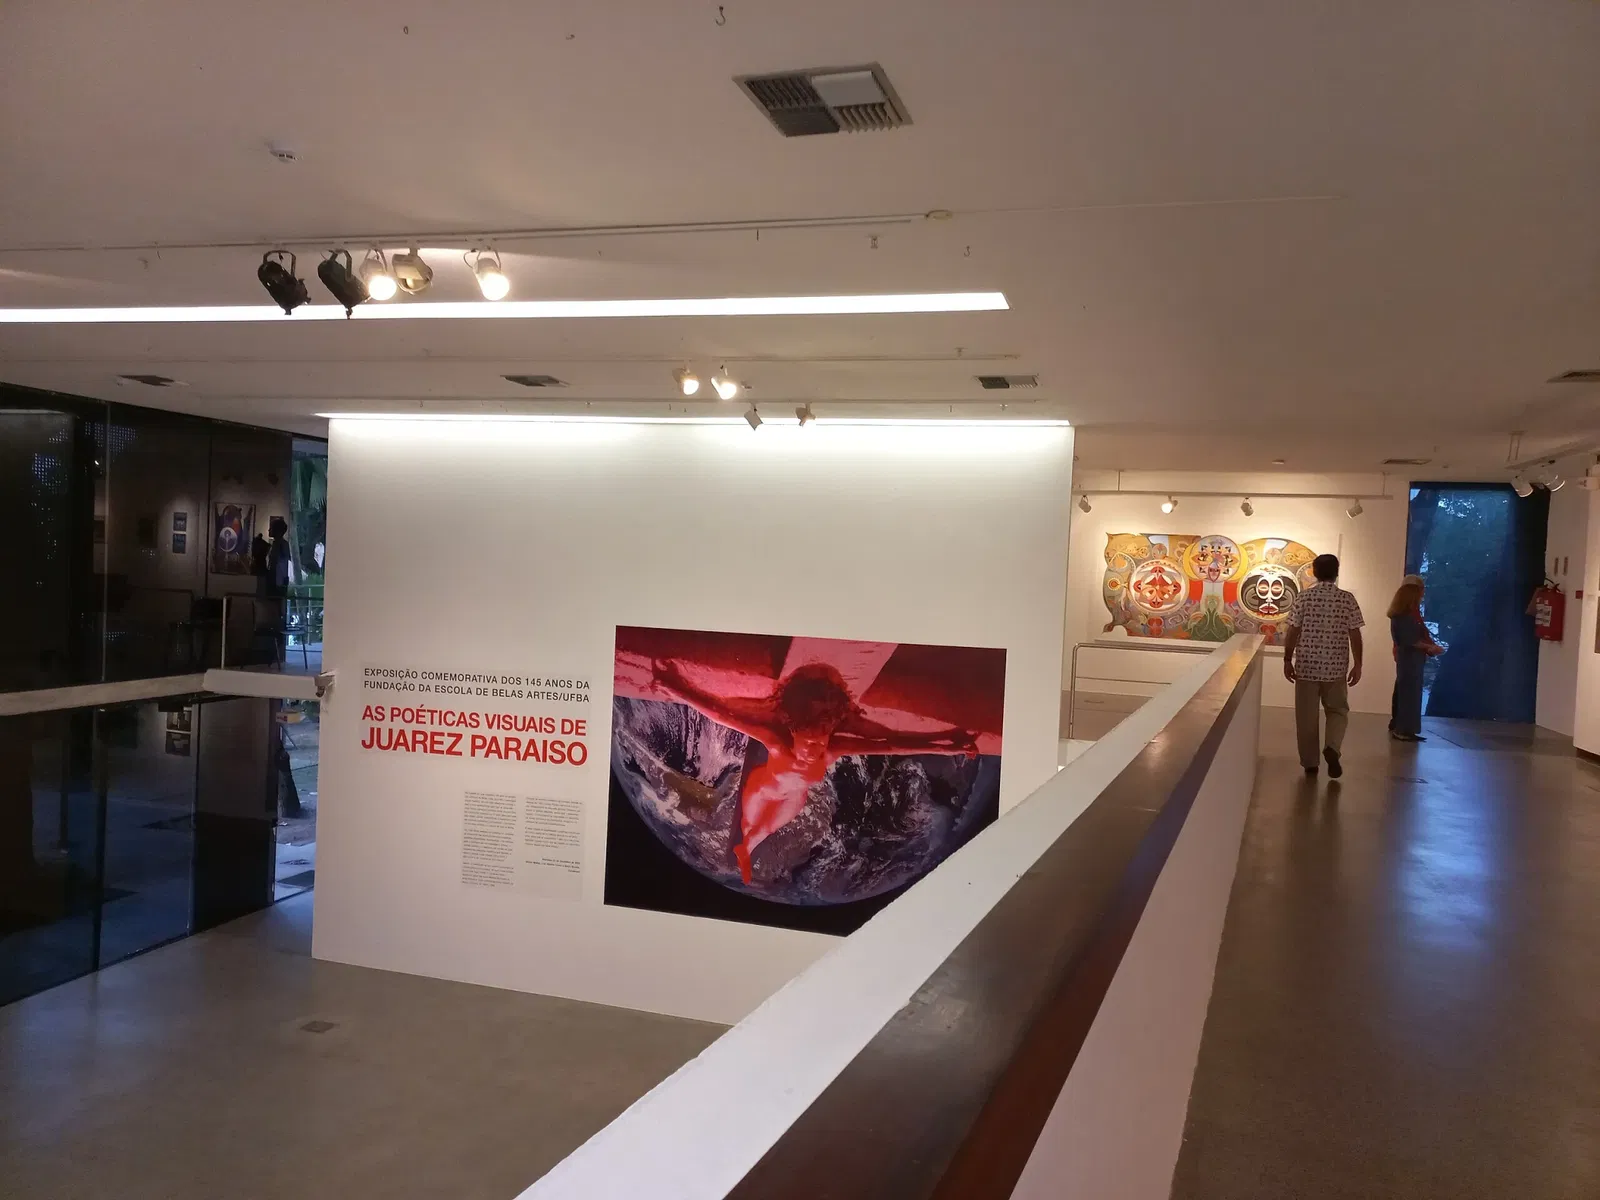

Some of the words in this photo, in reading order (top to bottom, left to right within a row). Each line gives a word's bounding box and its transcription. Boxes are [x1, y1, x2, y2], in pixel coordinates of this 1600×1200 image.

[364, 668, 417, 679] EXPOSIÇÃO
[421, 672, 497, 684] COMEMORATIVA
[501, 676, 521, 685] DOS
[526, 678, 541, 687] 145
[545, 679, 572, 689] ANOS
[576, 681, 590, 690] DA
[364, 681, 415, 692] FUNDAÇÃO
[418, 684, 431, 692] DA
[434, 685, 472, 695] ESCOLA
[492, 689, 523, 698] BELAS
[526, 691, 590, 702] ARTES/UFBA
[362, 706, 385, 722] AS
[390, 704, 480, 728] POÉTICAS
[485, 714, 555, 734] VISUAIS
[561, 719, 587, 736] DE
[361, 727, 463, 756] JUAREZ
[470, 734, 587, 766] PARAISO
